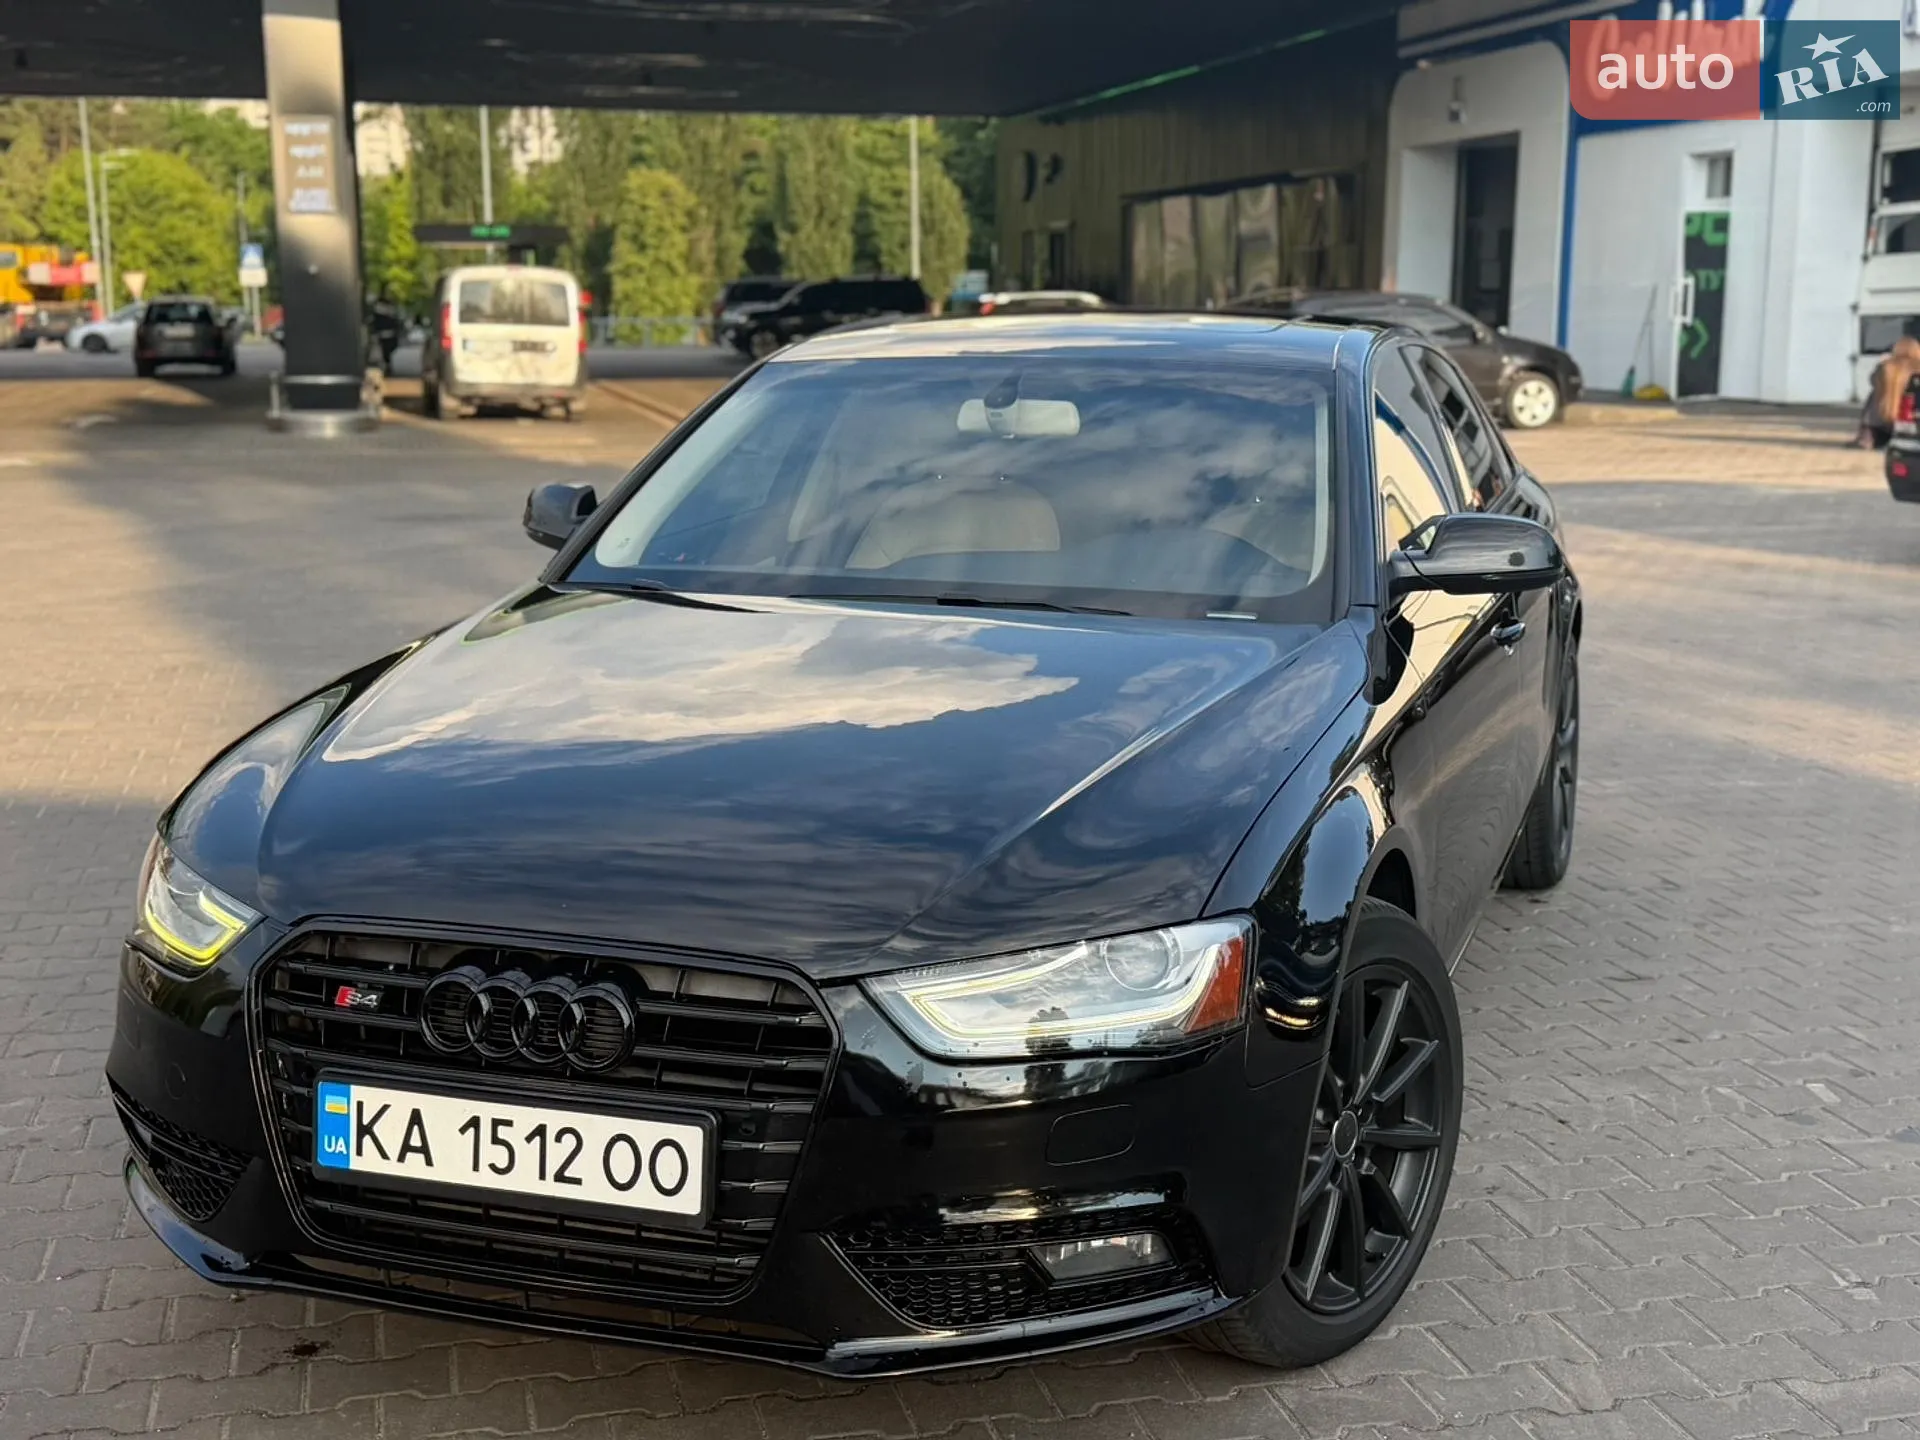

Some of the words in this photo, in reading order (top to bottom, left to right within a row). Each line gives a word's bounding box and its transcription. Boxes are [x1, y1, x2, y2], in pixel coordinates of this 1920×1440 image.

[345, 990, 378, 1008] S4
[324, 1135, 347, 1155] UA
[355, 1101, 434, 1168] KA
[458, 1115, 583, 1186] 1512
[603, 1133, 689, 1197] OO
